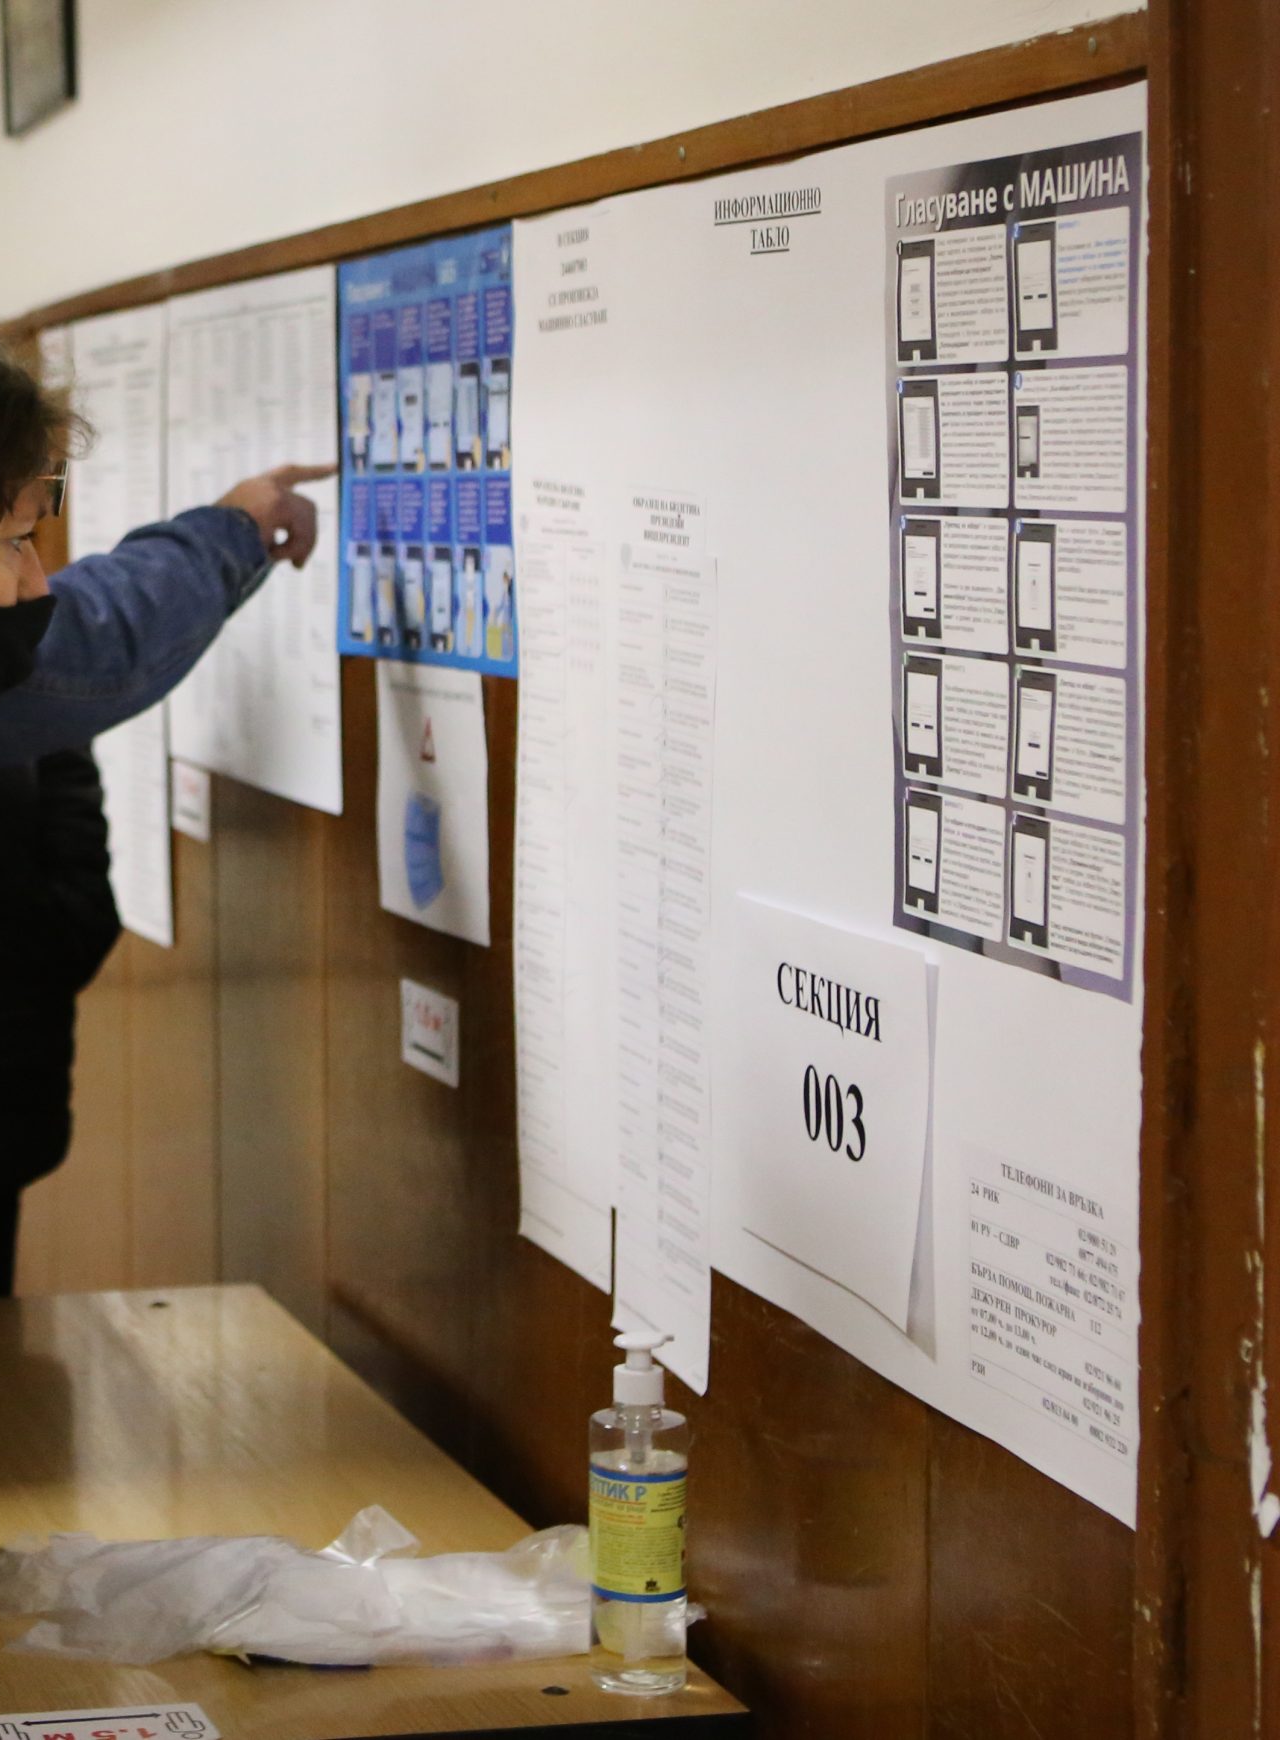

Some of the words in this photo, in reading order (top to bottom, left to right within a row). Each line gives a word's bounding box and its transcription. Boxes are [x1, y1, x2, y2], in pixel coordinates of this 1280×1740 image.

[714, 187, 821, 220] ИНФОРМАЦИОННО
[895, 184, 997, 232] Гласуване
[1003, 184, 1014, 212] с
[1020, 155, 1130, 209] МАШИНА
[750, 226, 790, 250] ТАБЛО
[777, 962, 882, 1042] СЕКЦИЯ
[803, 1064, 866, 1162] 003
[982, 1188, 1000, 1204] РИК
[1001, 1163, 1054, 1198] ТЕЛЕФОНИ
[1056, 1185, 1066, 1201] ЗА
[1069, 1191, 1104, 1220] ВРЪЗКА
[971, 1261, 997, 1284] БЪРЗА
[1035, 1290, 1076, 1322] ПОЖАРНА
[971, 1287, 1011, 1315] ДЕЖУРЕН
[1014, 1305, 1057, 1337] ПРОКУРОР
